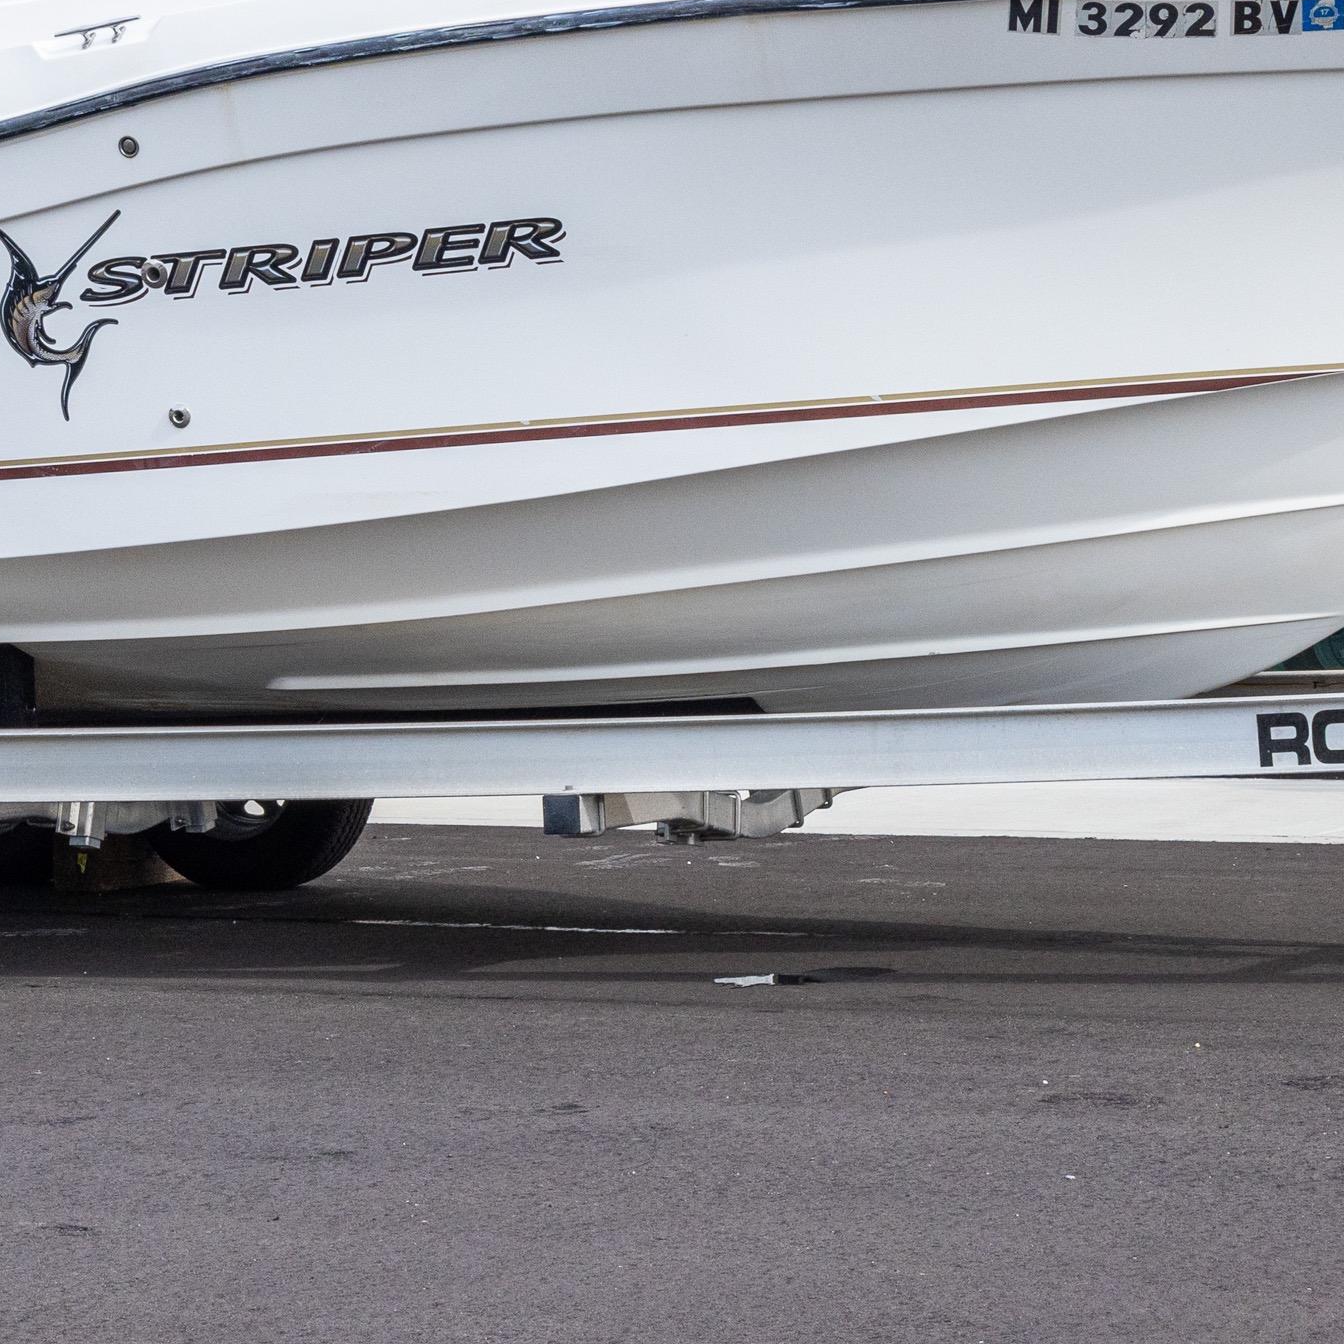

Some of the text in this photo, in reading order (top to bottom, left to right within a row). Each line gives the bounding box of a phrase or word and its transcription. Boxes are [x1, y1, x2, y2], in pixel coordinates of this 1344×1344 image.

[1078, 1, 1216, 37] 3292
[1233, 0, 1300, 35] BV
[80, 217, 567, 307] STRIPER
